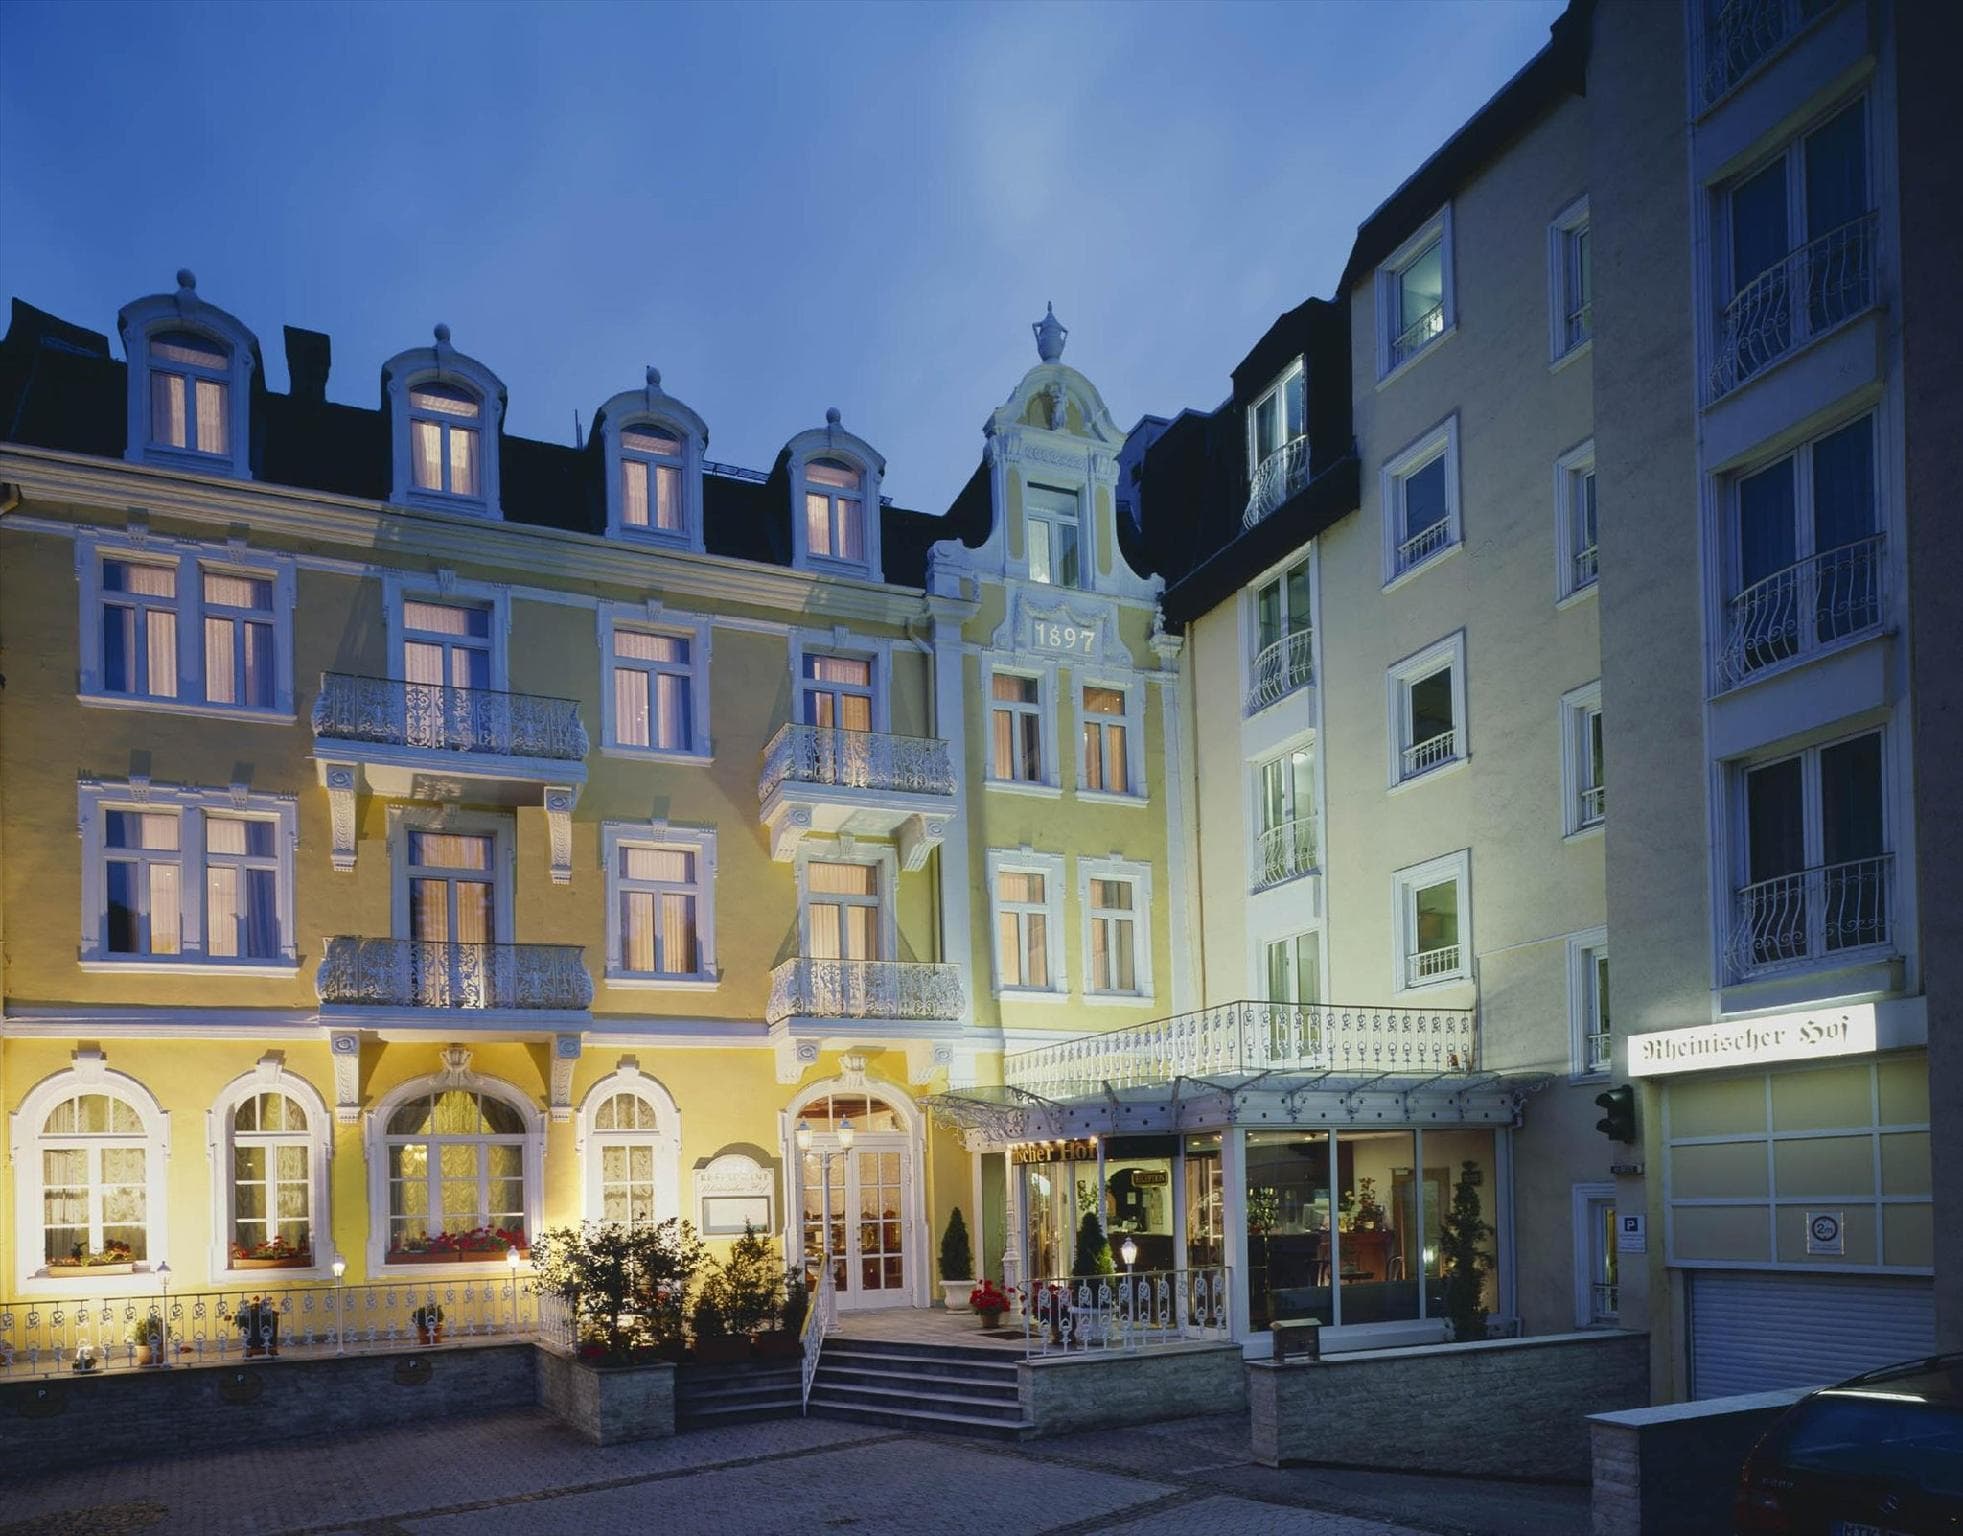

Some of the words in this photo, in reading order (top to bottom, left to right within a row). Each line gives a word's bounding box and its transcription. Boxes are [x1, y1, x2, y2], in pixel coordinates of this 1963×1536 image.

[1035, 623, 1095, 652] 1897
[1643, 1028, 1786, 1061] Rheinischer
[1800, 1015, 1849, 1044] Hof
[1626, 1220, 1636, 1230] P
[37, 1389, 46, 1399] P
